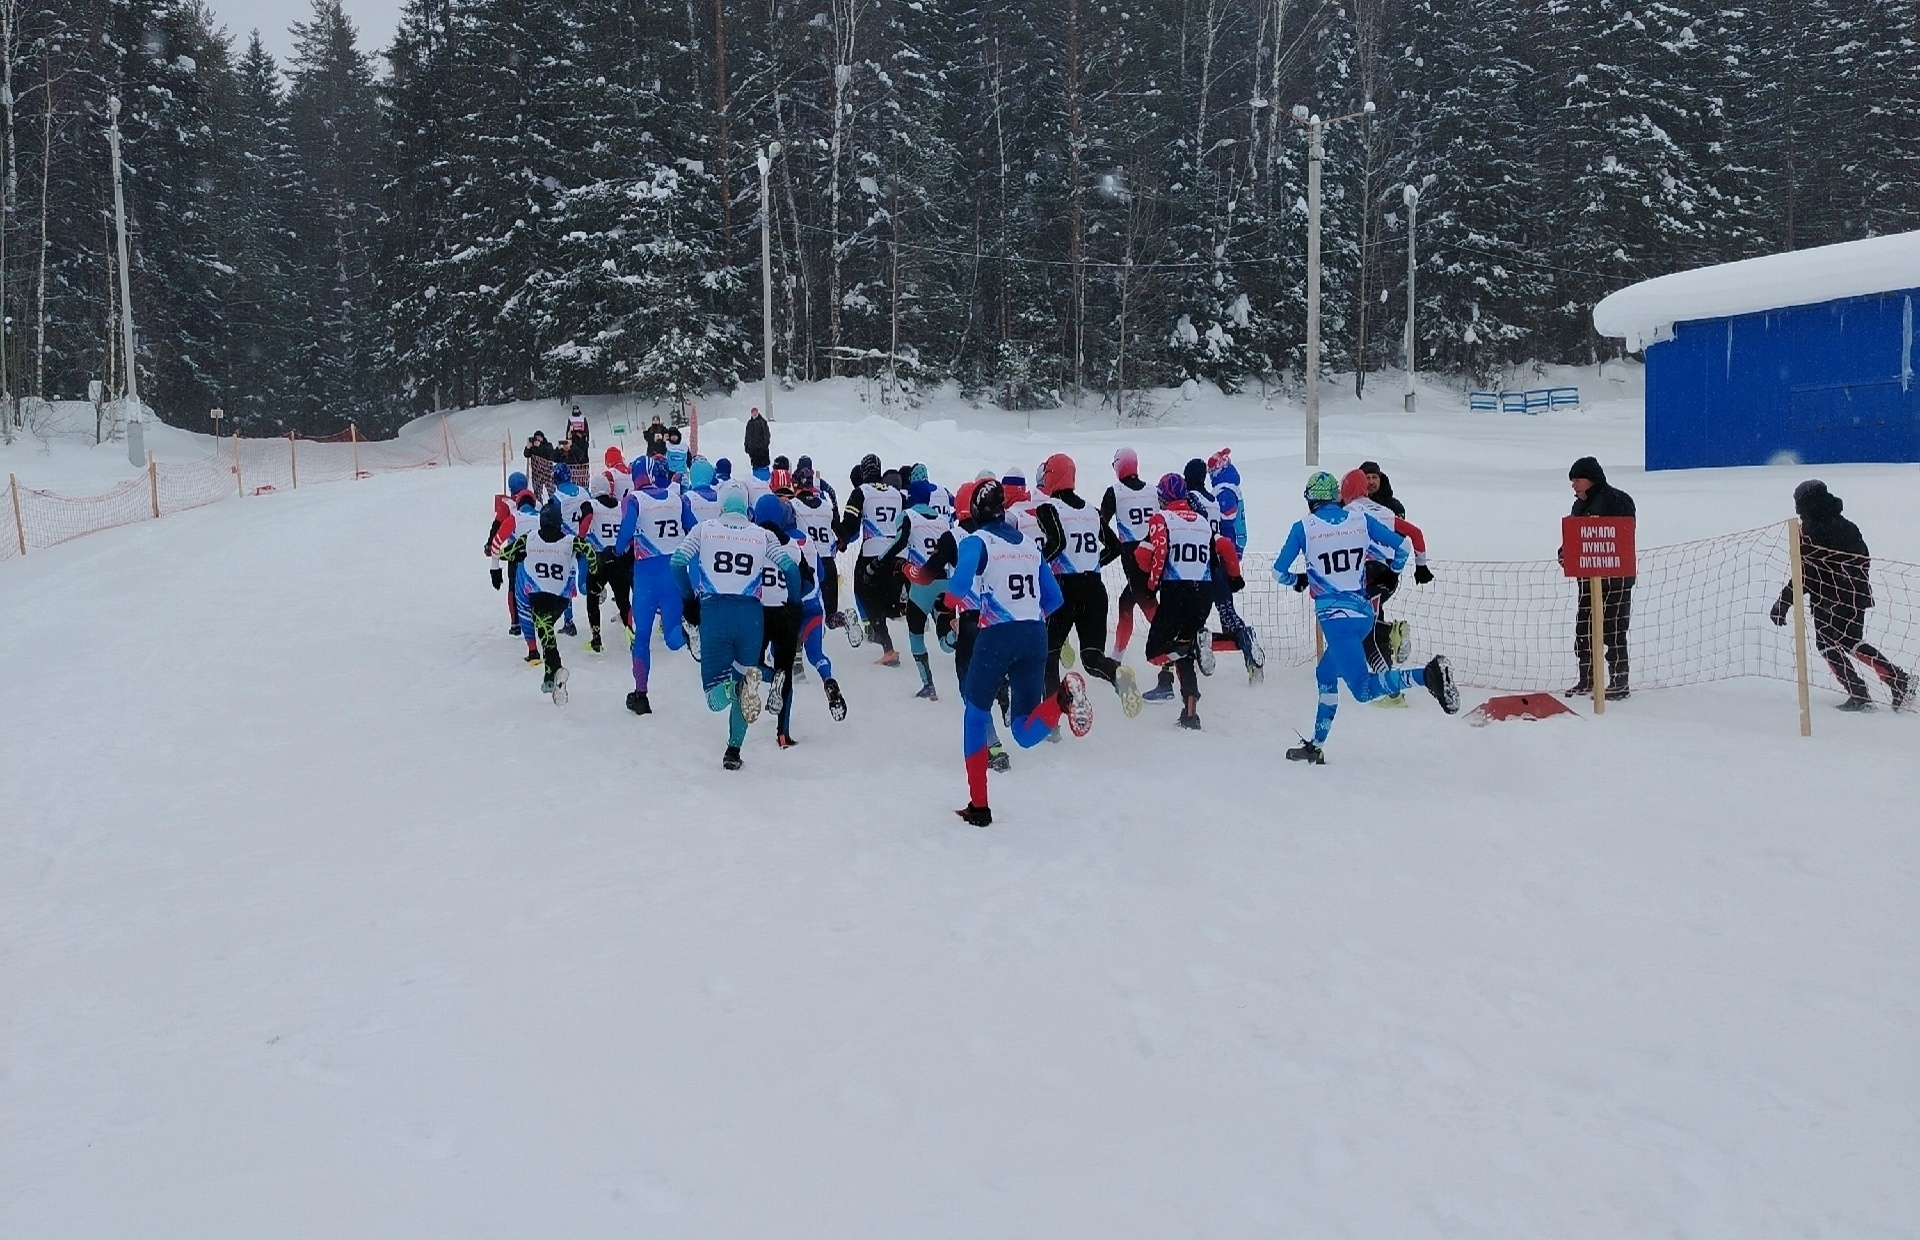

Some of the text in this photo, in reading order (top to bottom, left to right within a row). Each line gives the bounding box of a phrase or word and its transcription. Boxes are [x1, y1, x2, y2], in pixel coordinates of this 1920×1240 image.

[875, 506, 896, 522] 57
[1129, 508, 1154, 525] 95
[654, 520, 679, 538] 73
[808, 526, 829, 543] 96
[1581, 526, 1616, 538] НАЧАЛО
[1070, 532, 1097, 553] 78
[1582, 542, 1616, 553] ПУНКТА
[1172, 543, 1208, 564] 106
[1317, 547, 1364, 575] 107
[1580, 556, 1620, 568] ПИТАНИЯ
[535, 562, 564, 580] 98
[713, 551, 754, 576] 89
[1008, 574, 1037, 600] 91
